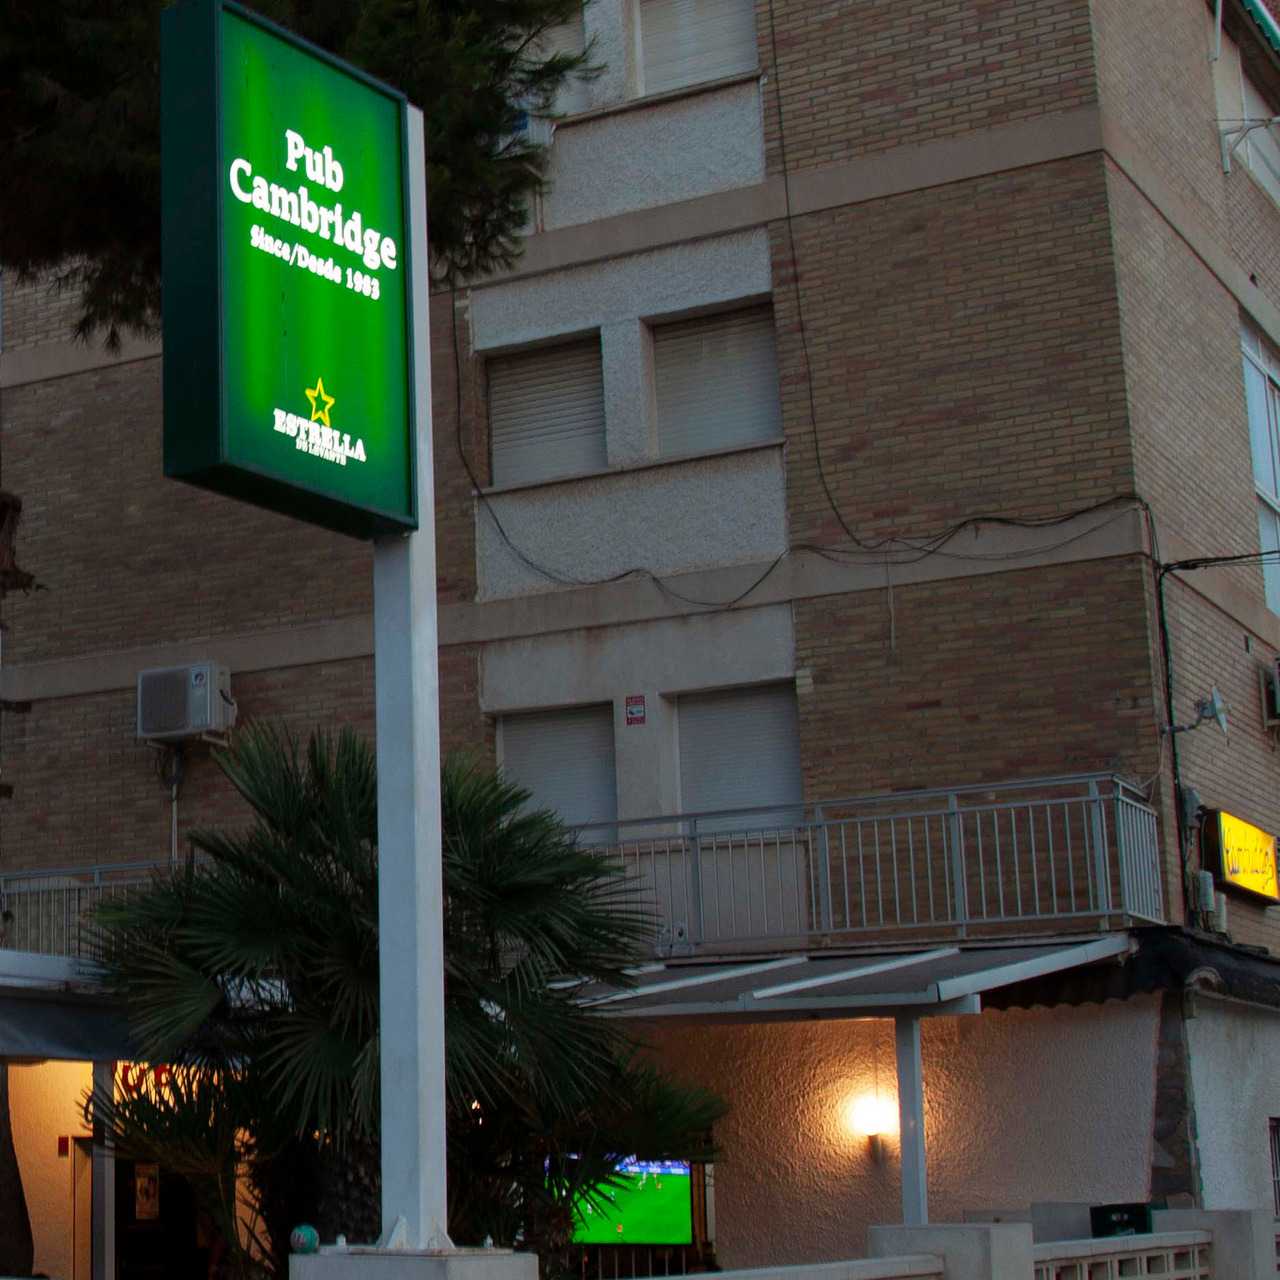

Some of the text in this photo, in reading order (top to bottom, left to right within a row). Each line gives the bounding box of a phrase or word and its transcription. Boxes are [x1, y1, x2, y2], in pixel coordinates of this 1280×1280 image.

[285, 128, 344, 193] Pub
[229, 157, 397, 270] Cambridge
[273, 407, 367, 463] ESTRELLA
